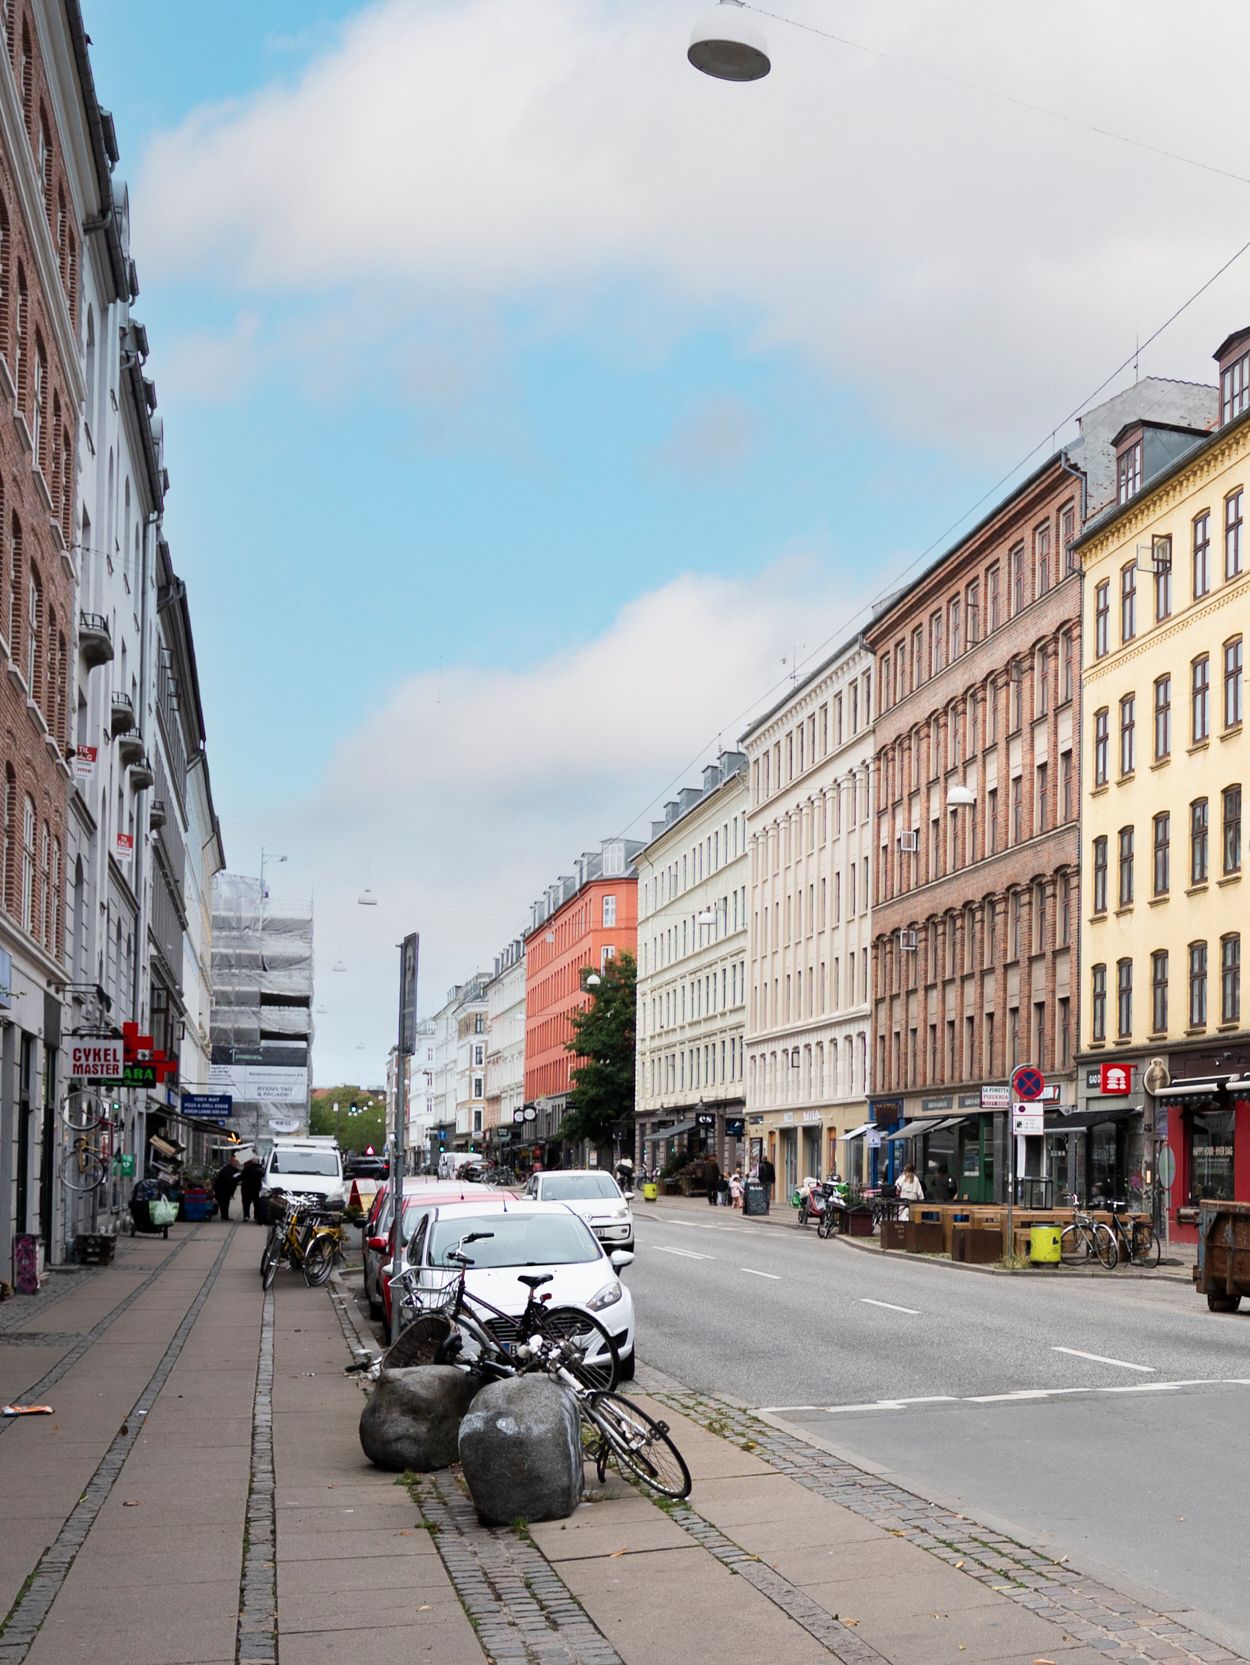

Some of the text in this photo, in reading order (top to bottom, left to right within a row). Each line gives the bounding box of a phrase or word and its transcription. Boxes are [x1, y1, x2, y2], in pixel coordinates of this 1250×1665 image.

[72, 1048, 119, 1062] CYKEL
[72, 1064, 119, 1075] MASTER
[124, 1068, 153, 1079] ARA
